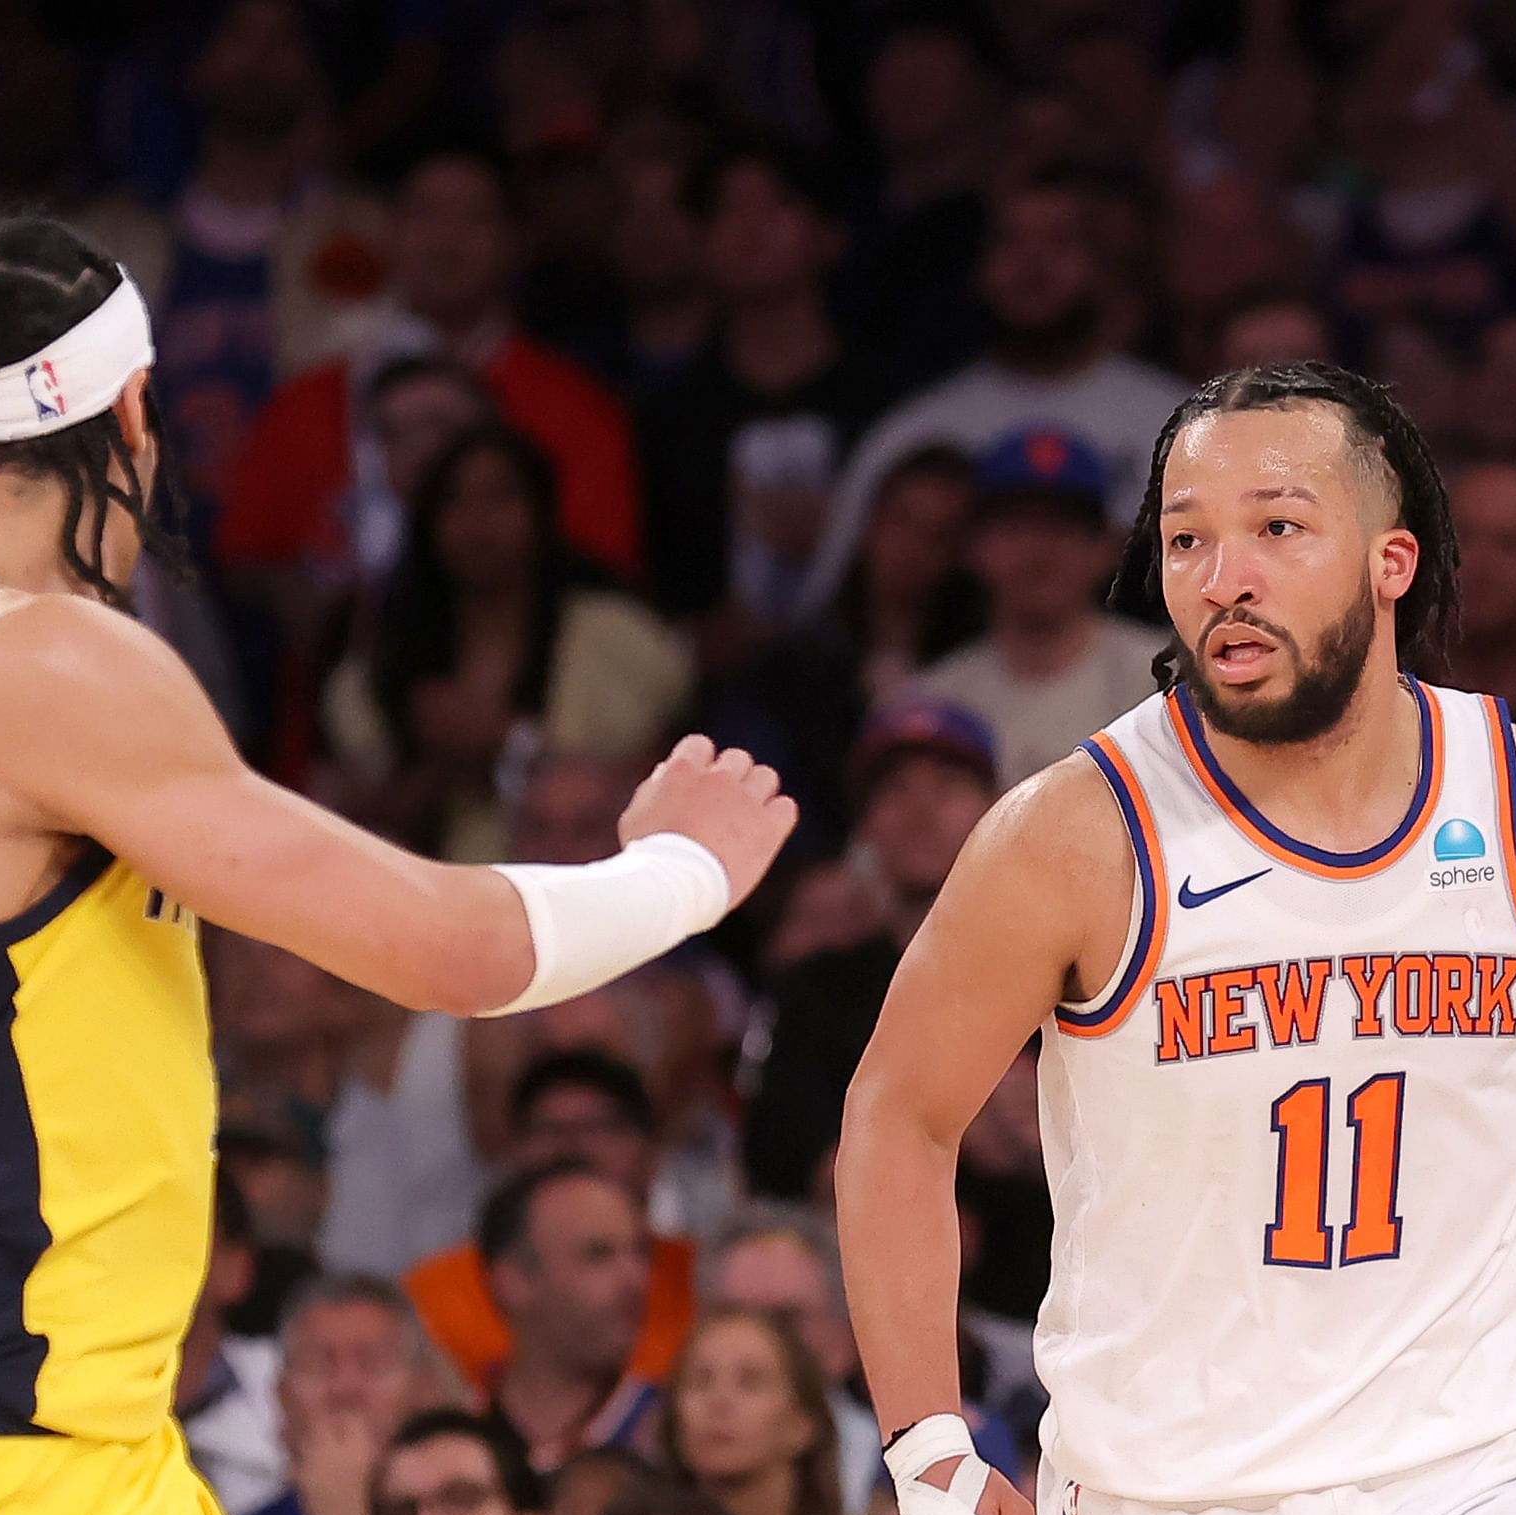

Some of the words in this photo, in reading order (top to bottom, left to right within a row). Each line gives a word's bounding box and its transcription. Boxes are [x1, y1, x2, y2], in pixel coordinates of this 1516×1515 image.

[1429, 865, 1495, 889] sphere
[1154, 955, 1335, 1066] NEW
[1263, 1071, 1406, 1270] 11
